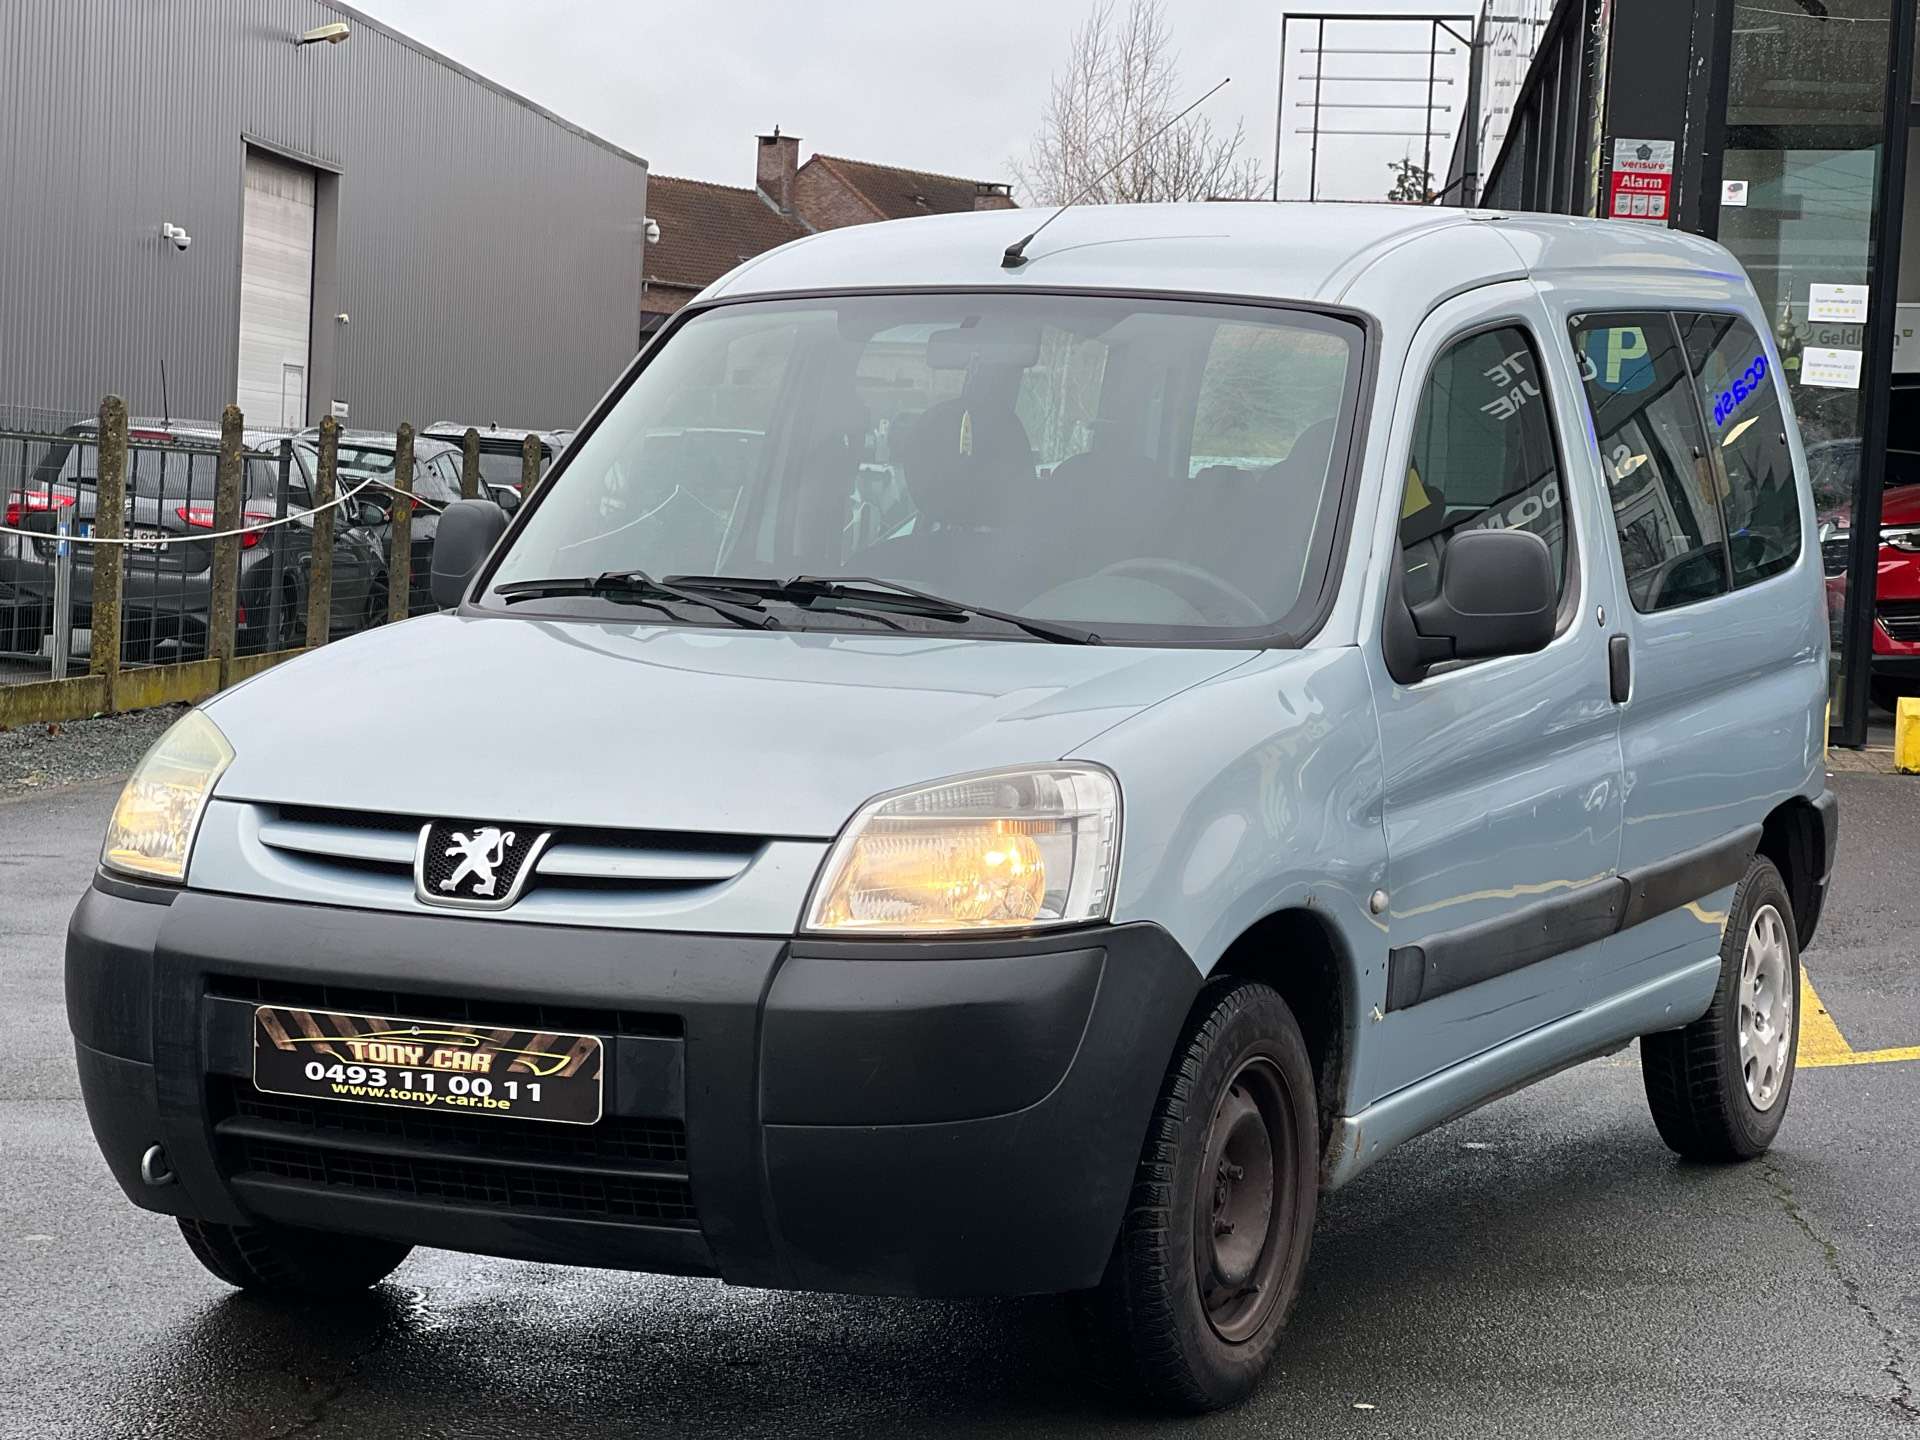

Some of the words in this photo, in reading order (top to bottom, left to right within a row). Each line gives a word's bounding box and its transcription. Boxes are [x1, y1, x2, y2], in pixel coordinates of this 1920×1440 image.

[1621, 160, 1665, 170] verisure
[1620, 174, 1663, 189] Alarm
[349, 1041, 424, 1065] TONY
[433, 1049, 493, 1073] CAR
[304, 1061, 388, 1087] 0493
[399, 1072, 435, 1092] 11
[448, 1076, 493, 1097] 00
[503, 1081, 542, 1102] 11
[331, 1082, 511, 1110] www.tony-car.be
